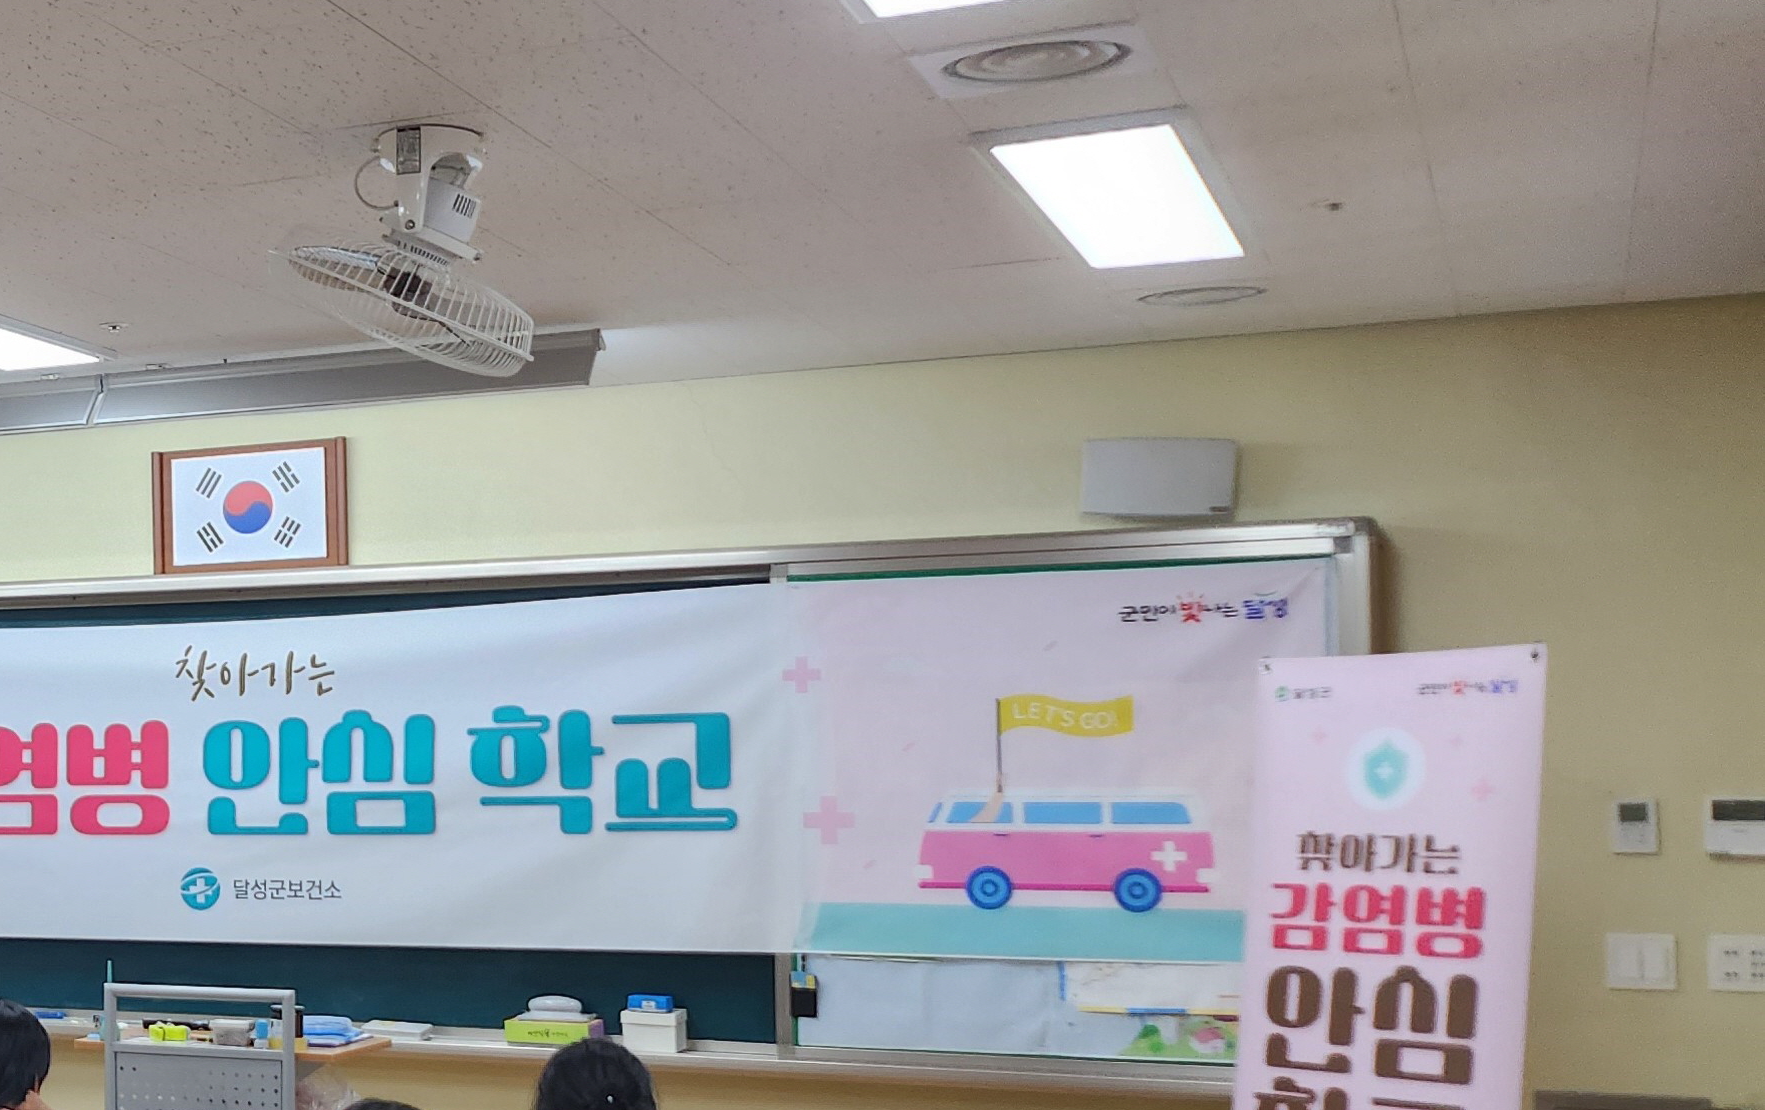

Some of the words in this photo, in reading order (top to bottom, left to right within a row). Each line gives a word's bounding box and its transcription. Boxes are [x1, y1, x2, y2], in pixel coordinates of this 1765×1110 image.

[174, 644, 335, 702] 찾아가는
[202, 709, 436, 836] 안심
[466, 704, 739, 834] 학교
[1296, 831, 1460, 874] 찾아가는
[233, 878, 343, 901] 달성군보건소
[1269, 882, 1486, 959] 감염병
[1264, 964, 1478, 1086] 안심
